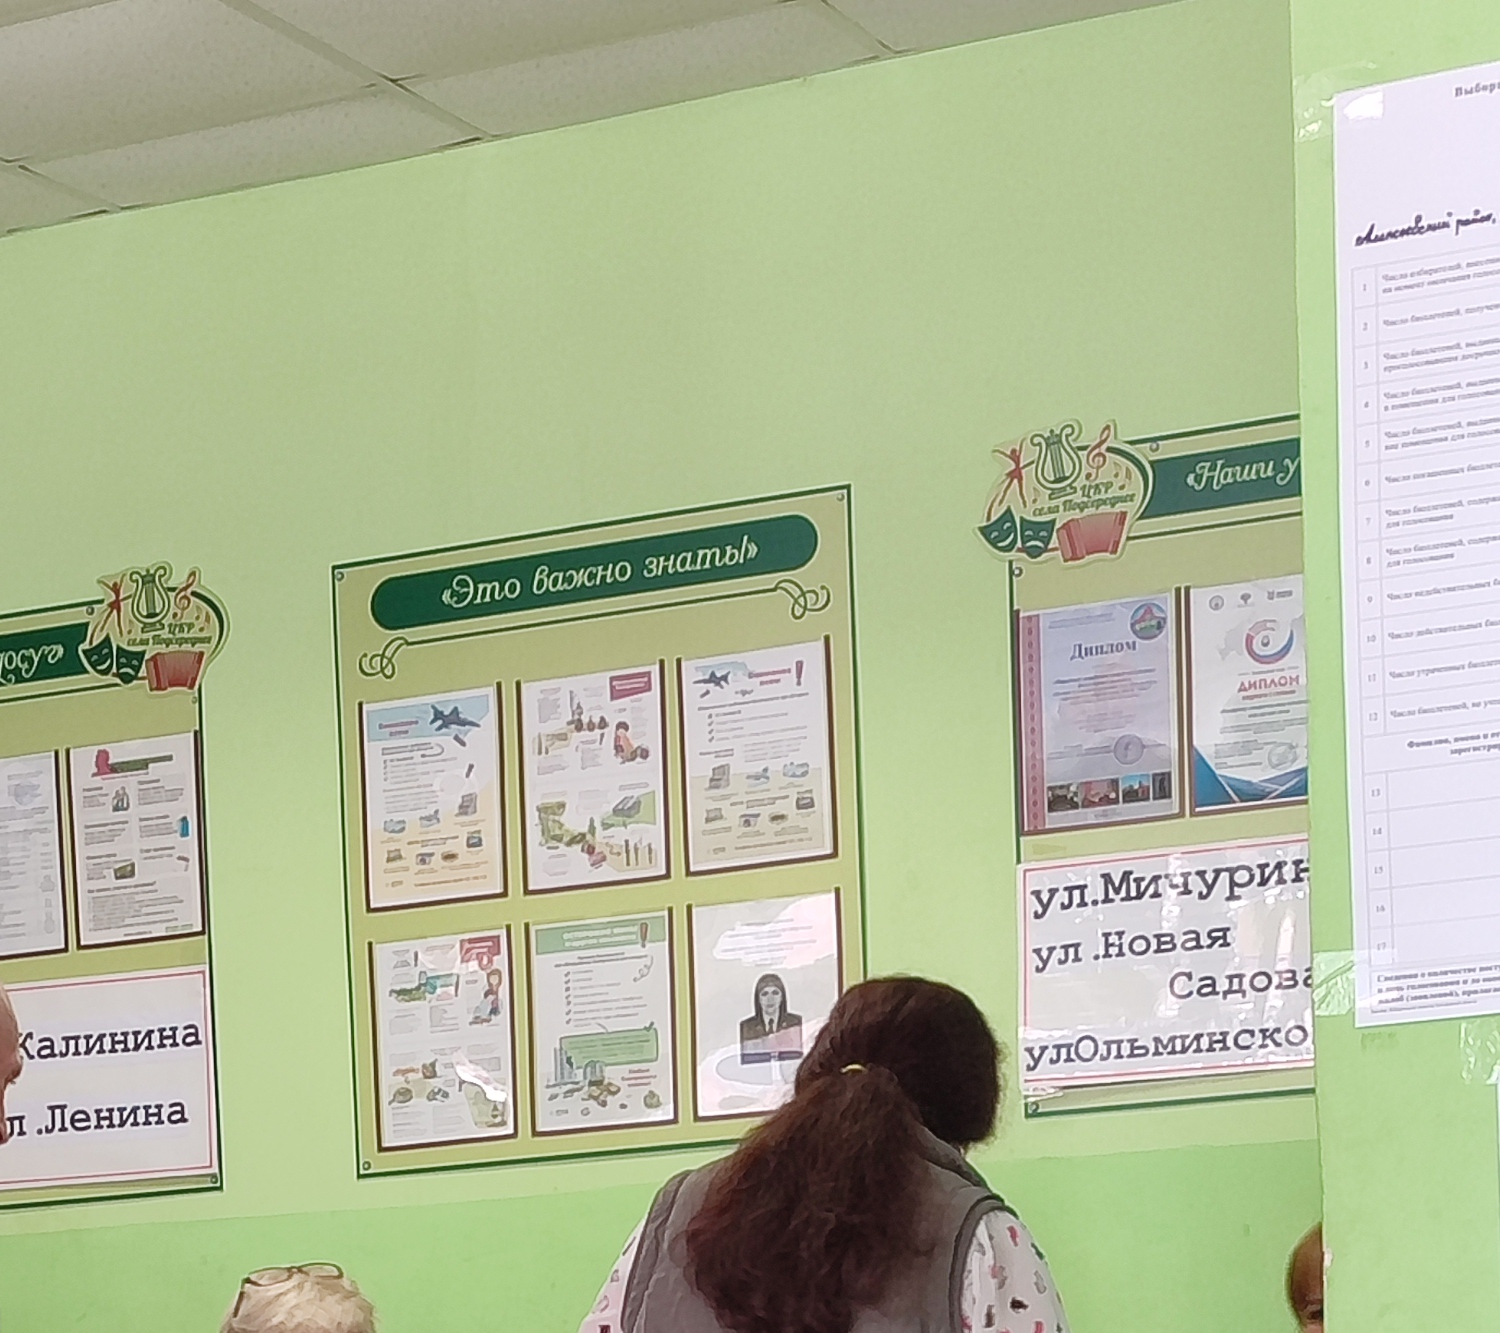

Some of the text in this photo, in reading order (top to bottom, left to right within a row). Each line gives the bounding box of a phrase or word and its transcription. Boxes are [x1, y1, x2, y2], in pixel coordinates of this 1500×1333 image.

[1454, 81, 1500, 98] Выбор
[441, 535, 758, 609] «Это важно знать!»
[1069, 640, 1138, 662] Диплом
[1237, 674, 1301, 694] ДИПЛОМ
